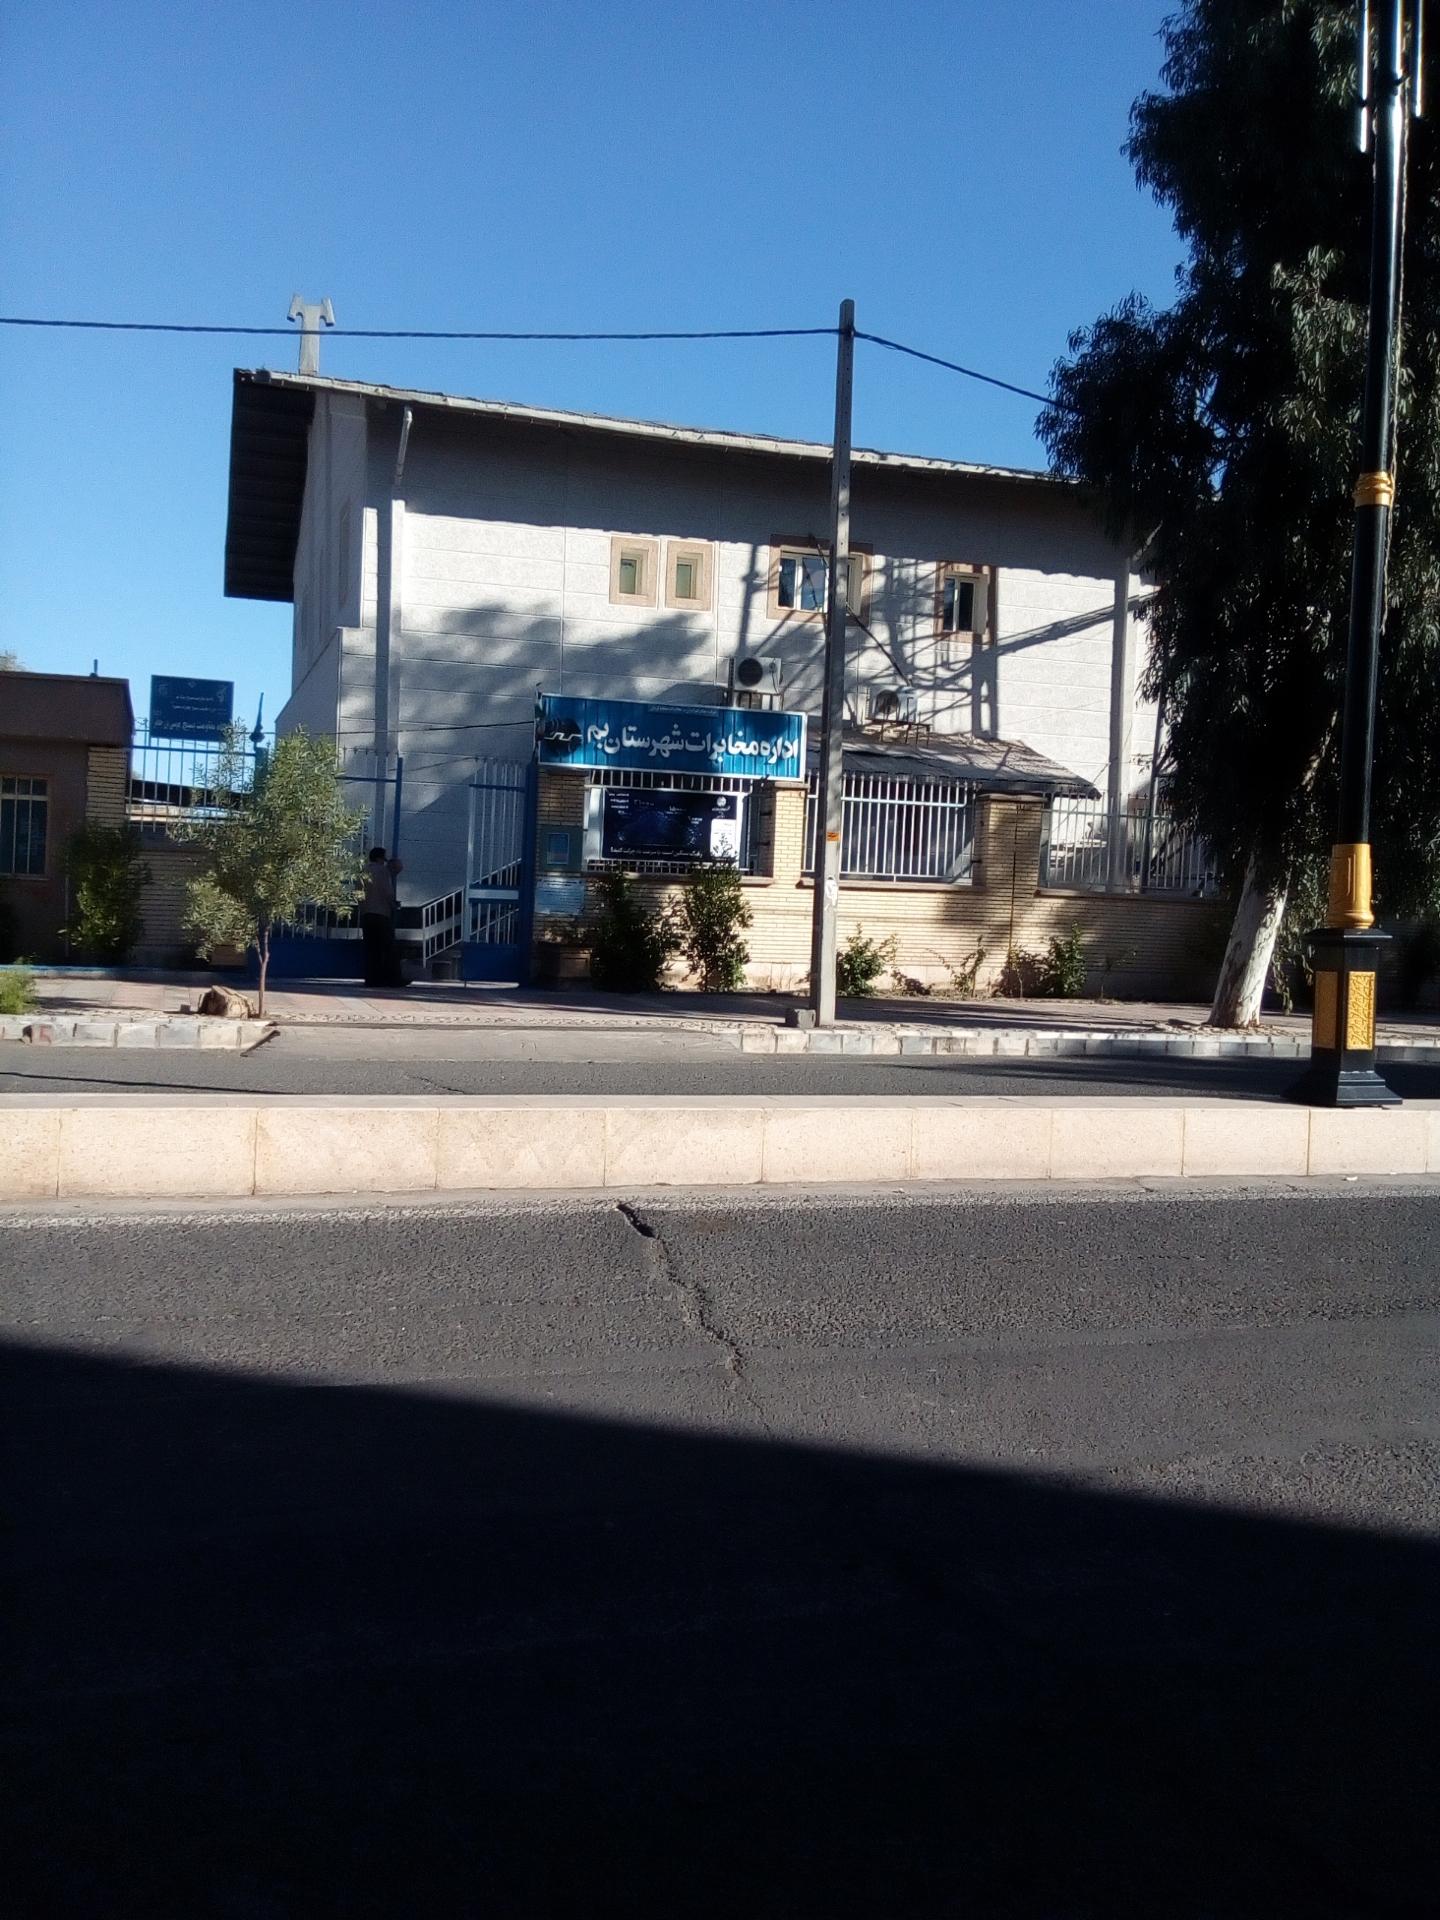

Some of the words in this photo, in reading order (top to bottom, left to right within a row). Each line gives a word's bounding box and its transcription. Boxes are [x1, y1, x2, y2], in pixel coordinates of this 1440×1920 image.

[587, 722, 609, 749] بم
[603, 723, 685, 758] شهرستان
[684, 730, 759, 763] مخابرات
[760, 736, 799, 764] اداره
